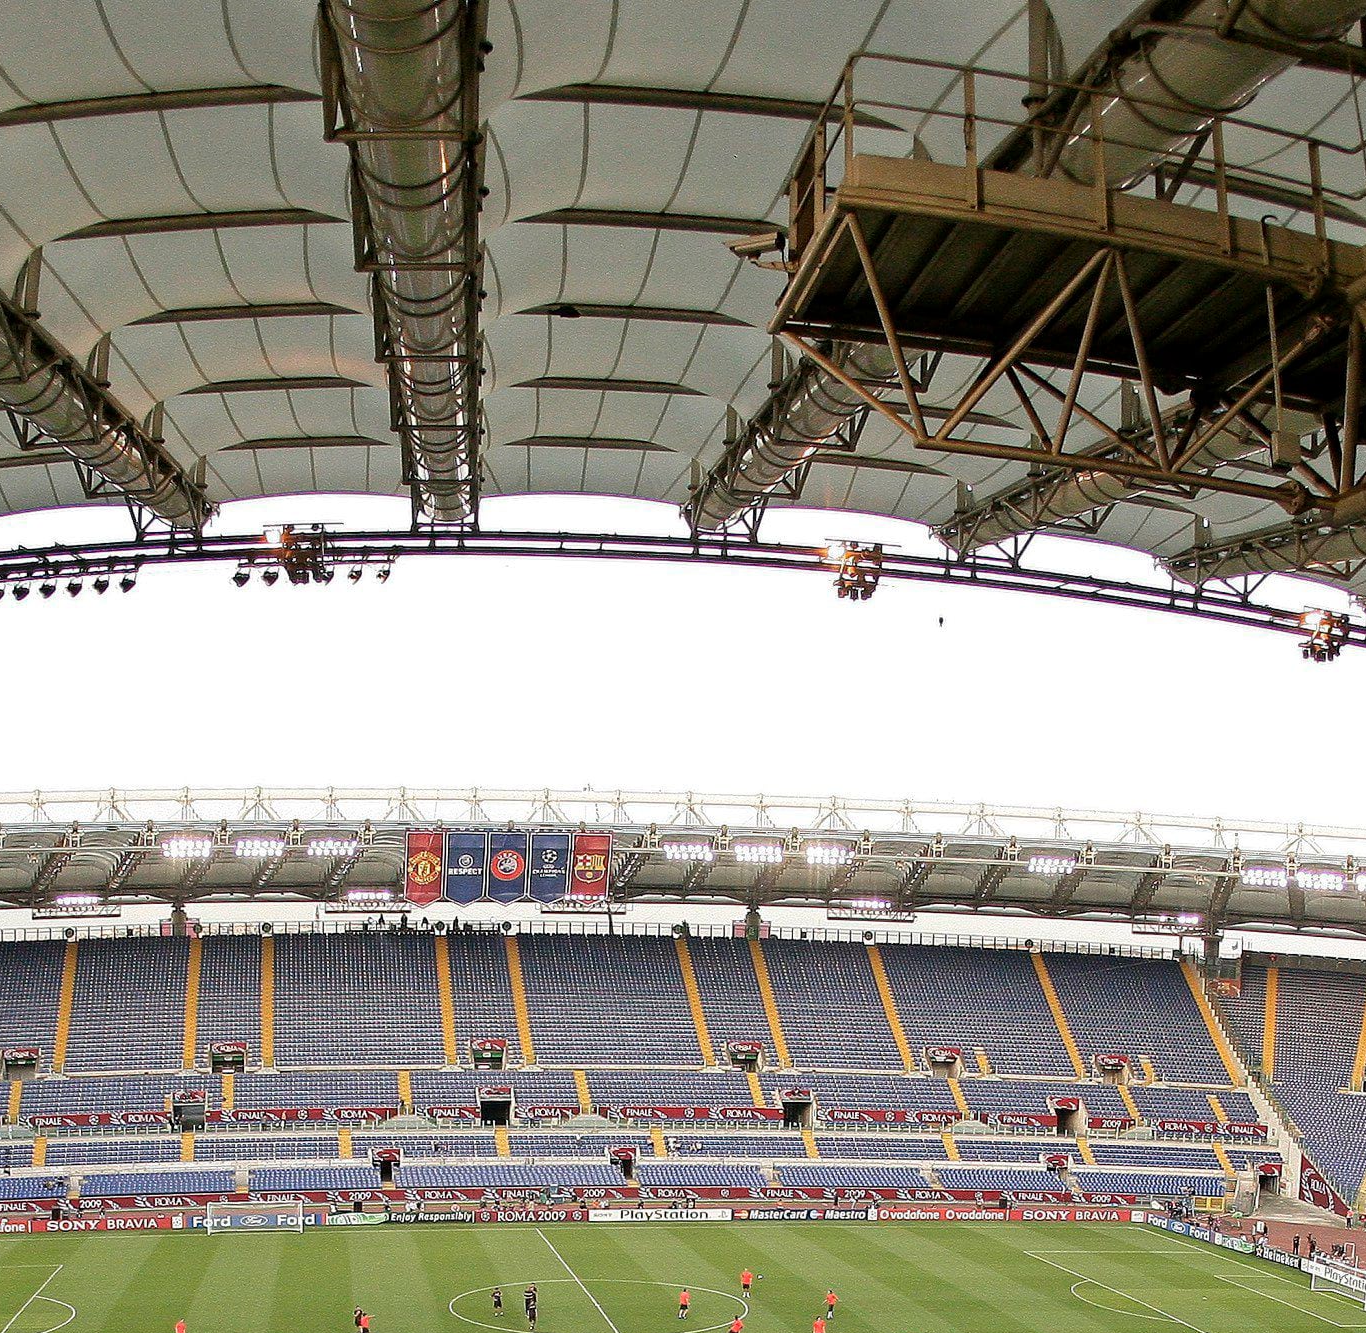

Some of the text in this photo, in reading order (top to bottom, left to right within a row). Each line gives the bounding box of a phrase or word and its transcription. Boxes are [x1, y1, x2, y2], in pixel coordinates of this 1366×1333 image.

[340, 1108, 460, 1119] ROMA FINALE
[535, 1108, 653, 1117] ROMA FINALE
[727, 1110, 860, 1120] ROMA FINALE
[35, 1117, 62, 1126] FINALE
[128, 1114, 155, 1123] ROMA
[921, 1114, 1121, 1128] ROMA FINALE 2009
[1232, 1126, 1254, 1135] FINALE
[155, 1197, 183, 1206] ROMA
[348, 1192, 371, 1200] 2009
[424, 1191, 452, 1199] ROMA
[767, 1190, 794, 1198] FINALE
[915, 1191, 1112, 1203] ROMA FINALE 2009
[0, 1203, 27, 1211] FINALE
[80, 1200, 101, 1208] 2009
[277, 1214, 315, 1225] Ford
[391, 1213, 417, 1222] Enjoy
[418, 1211, 472, 1222] Responsibly
[497, 1212, 566, 1222] ROMA 2009
[620, 1209, 709, 1220] PlayStation
[750, 1210, 807, 1220] MasterCard
[825, 1210, 866, 1219] Maestro
[890, 1211, 939, 1220] vodafone
[955, 1210, 1004, 1220] vodafone
[1022, 1210, 1119, 1220] SONY BRAVIA
[46, 1218, 158, 1231] SONY BRAVIA
[193, 1216, 231, 1228] Ford
[1147, 1216, 1168, 1229] Ford
[1189, 1227, 1210, 1241] Ford
[1263, 1250, 1300, 1268] Heineken
